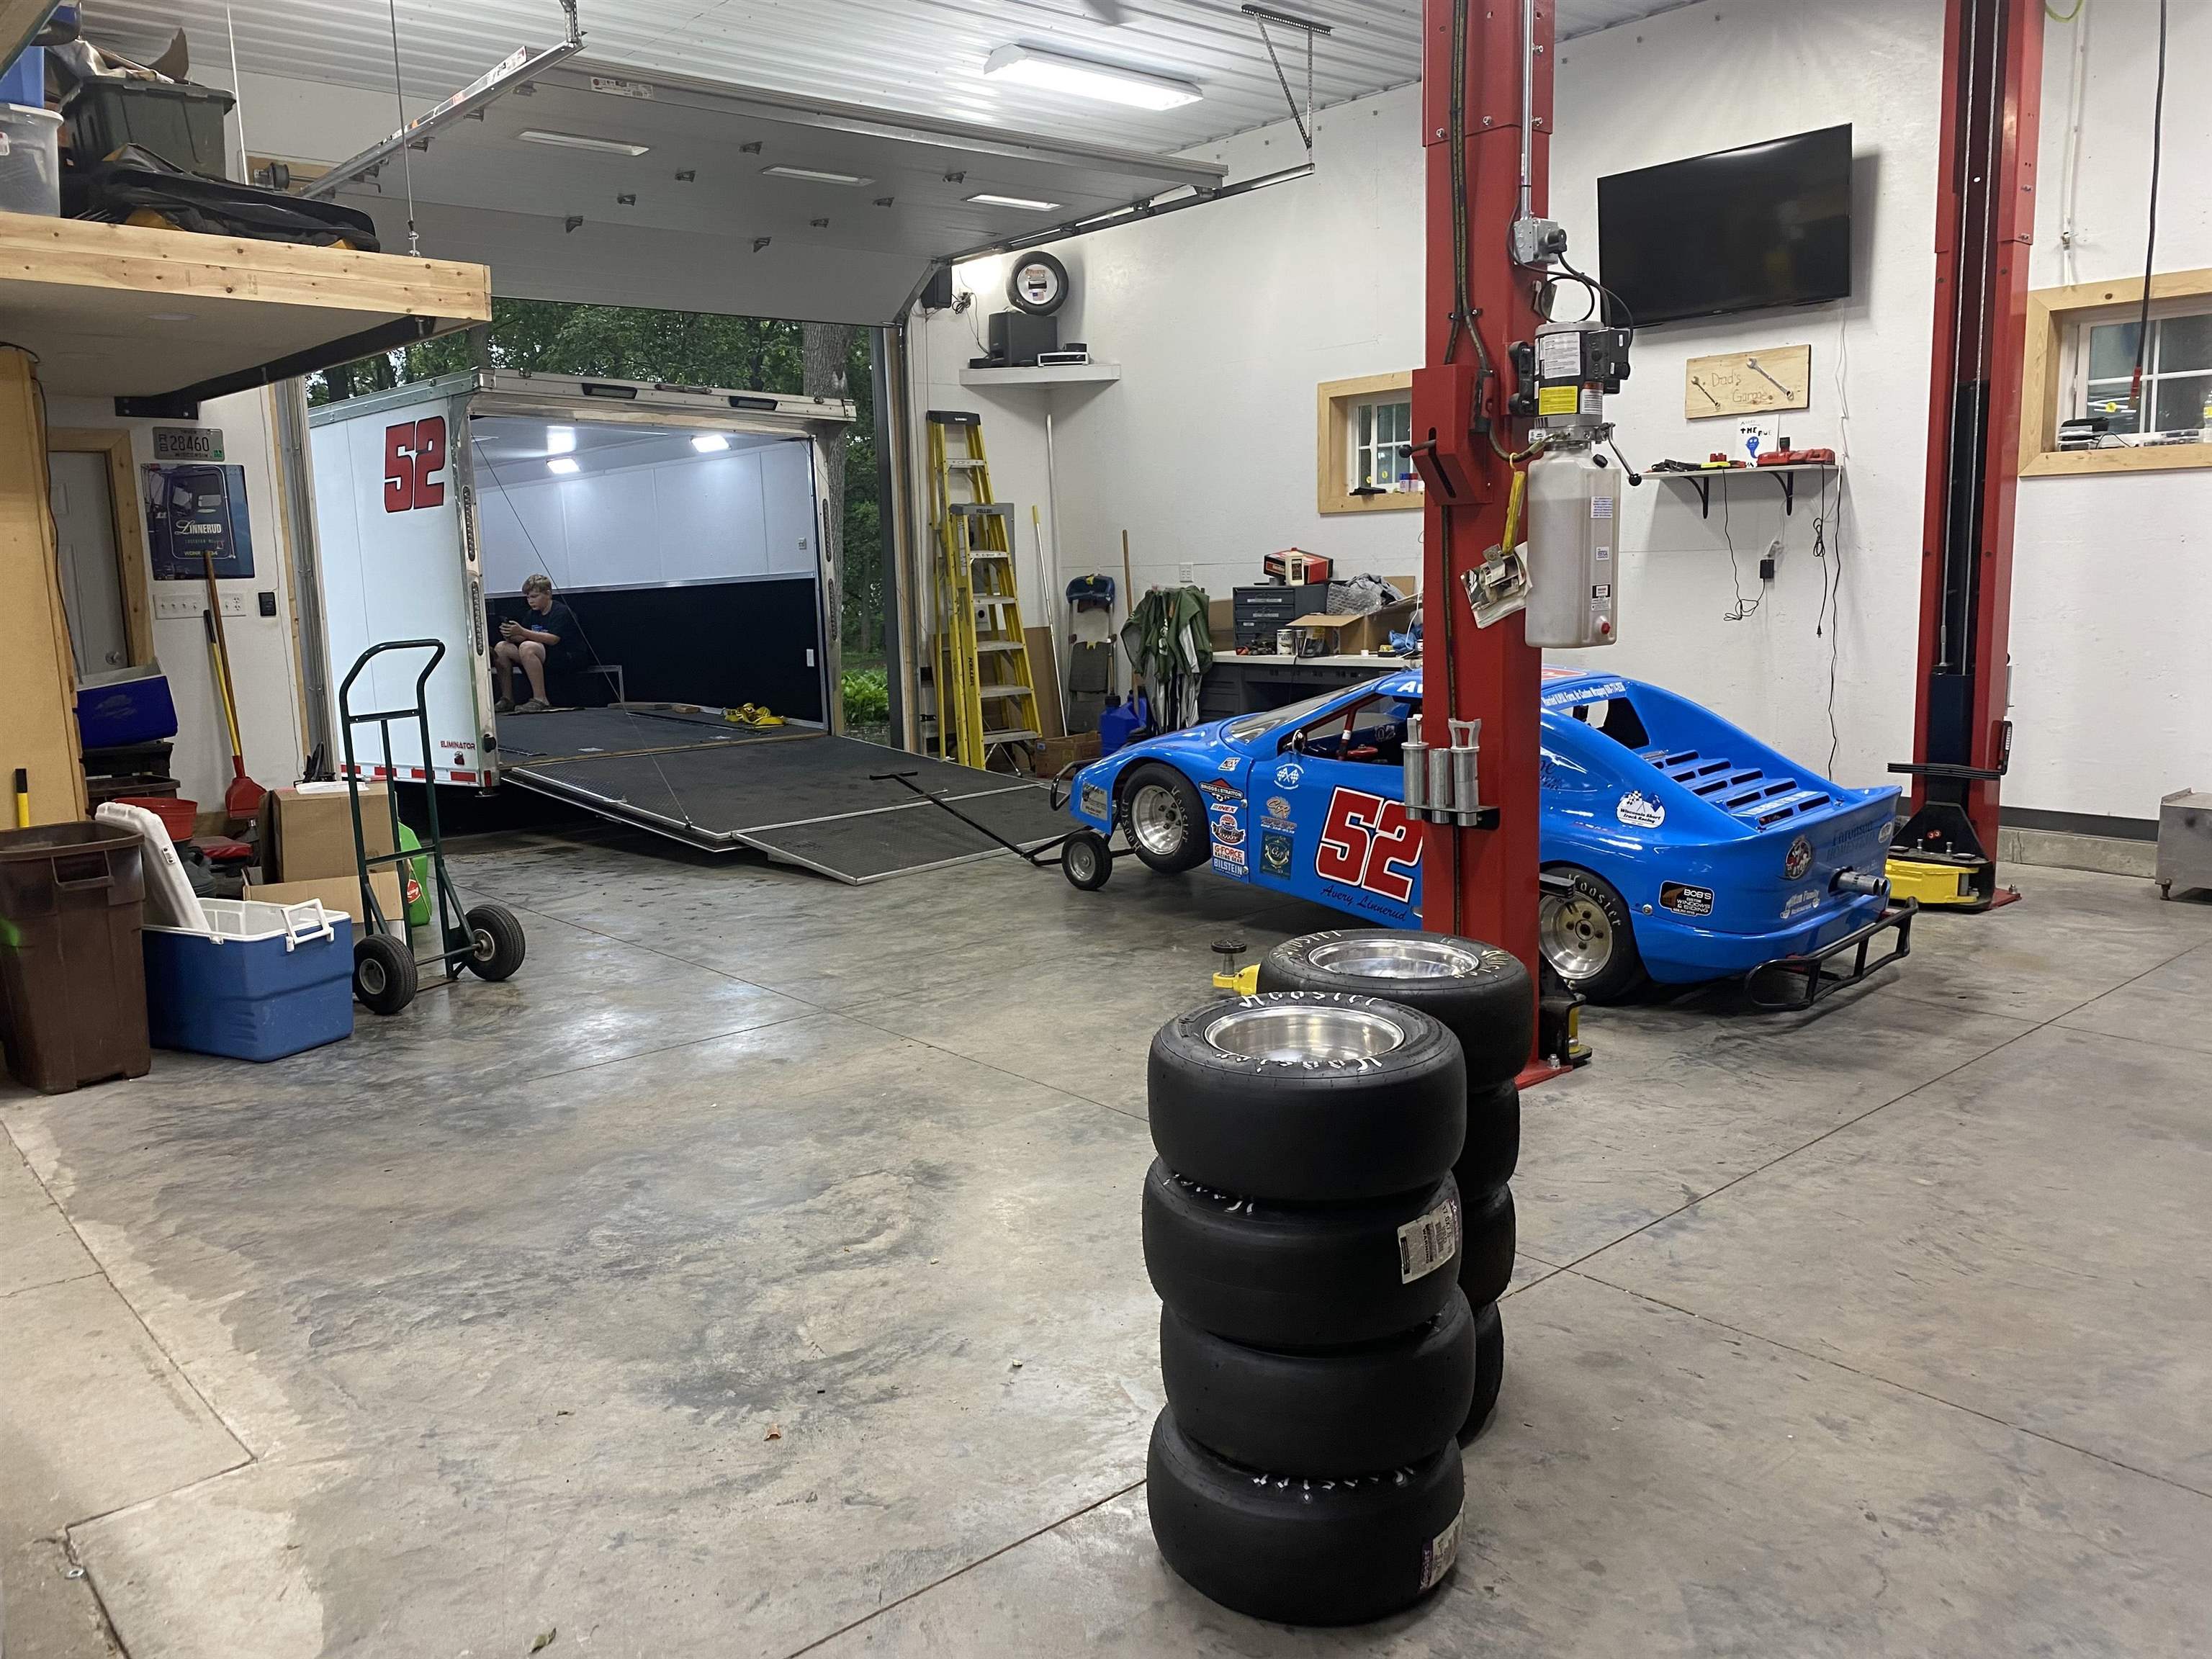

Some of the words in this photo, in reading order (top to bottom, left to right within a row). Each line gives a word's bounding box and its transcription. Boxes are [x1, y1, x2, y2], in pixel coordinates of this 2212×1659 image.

[1712, 369, 1741, 387] Dad's
[170, 436, 210, 451] 28460
[385, 415, 446, 513] 52
[440, 740, 475, 750] ELIMINATOR
[1620, 808, 1645, 817] Wisconsin
[1214, 845, 1243, 859] G-FORCE
[1315, 785, 1423, 904] 52
[1214, 858, 1243, 875] BILSTEIN
[1683, 889, 1712, 900] BOB'S
[1321, 885, 1354, 906] Avery
[1357, 897, 1408, 922] Linnerud
[1676, 899, 1711, 909] WINDOWS
[1239, 991, 1382, 1008] Hoosier
